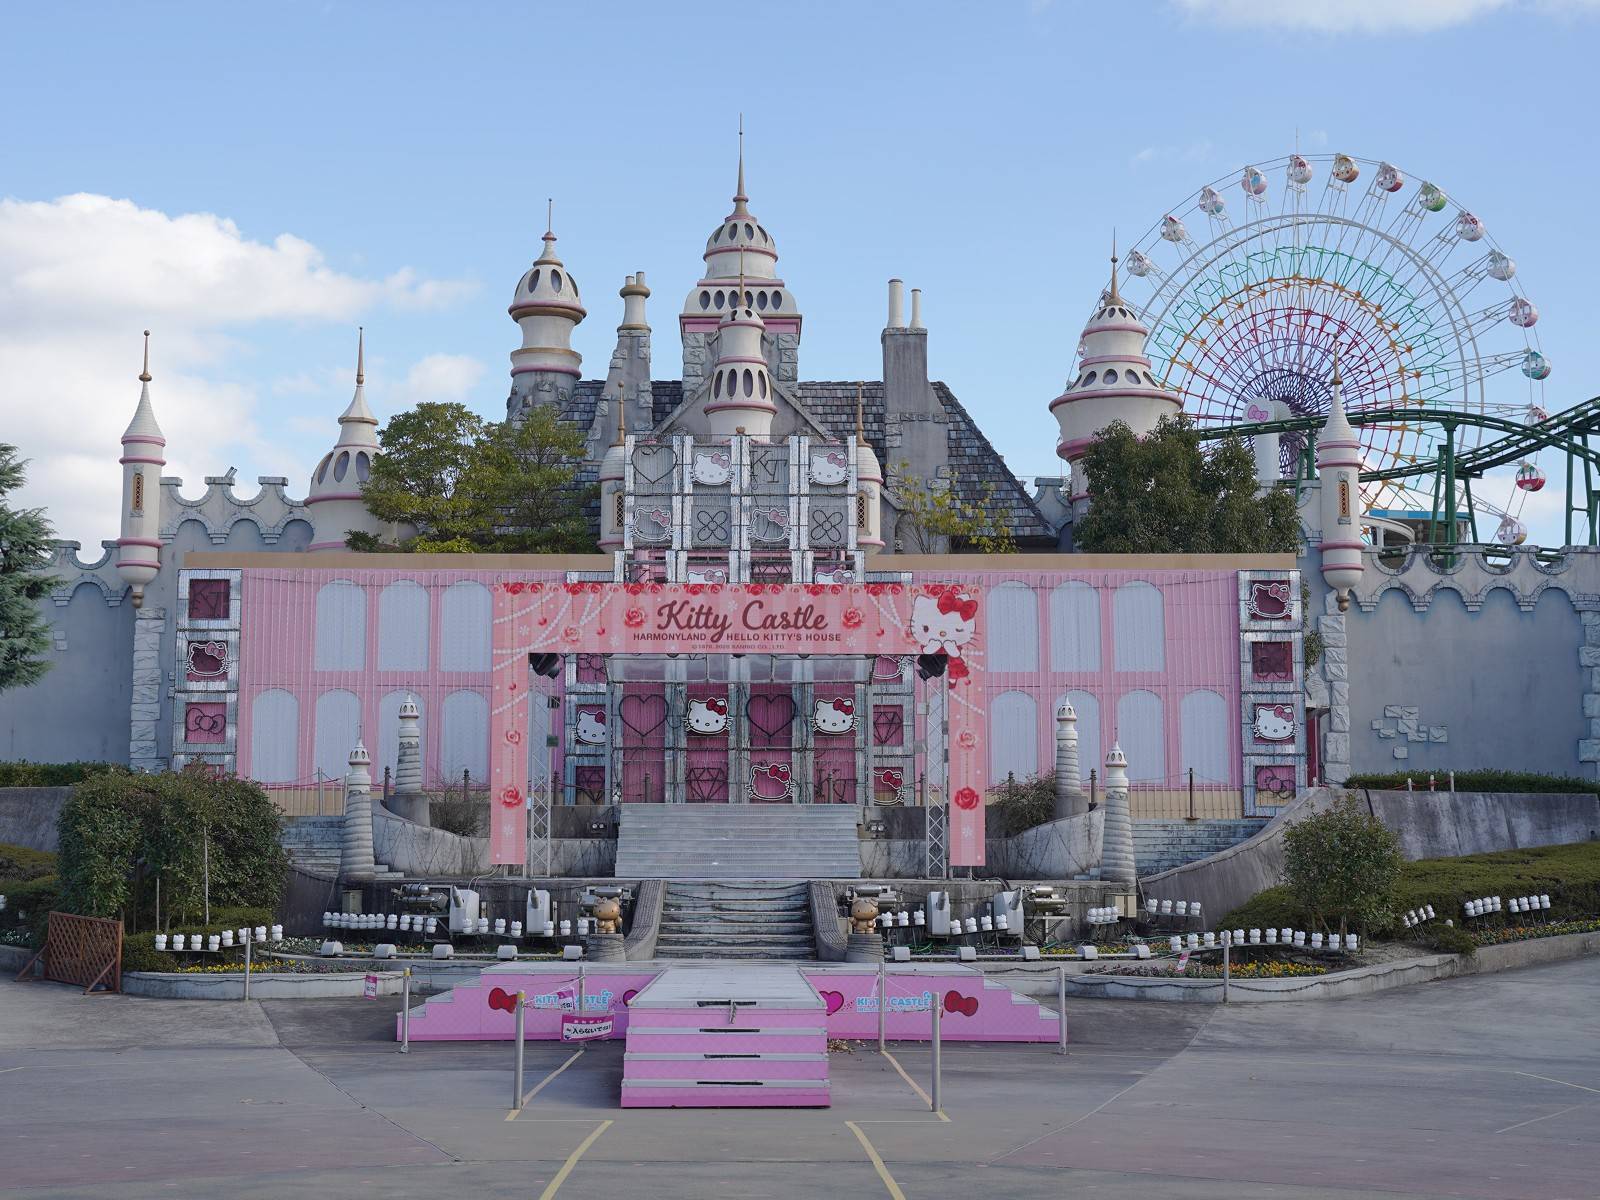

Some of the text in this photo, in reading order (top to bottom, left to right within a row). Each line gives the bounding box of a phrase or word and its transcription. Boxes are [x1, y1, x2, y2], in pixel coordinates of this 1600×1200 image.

[657, 600, 828, 642] Kitty Castle
[726, 633, 760, 641] HELLO
[763, 633, 802, 641] KITTY'S
[806, 633, 841, 641] HOUSE
[890, 997, 929, 1006] CASTLE
